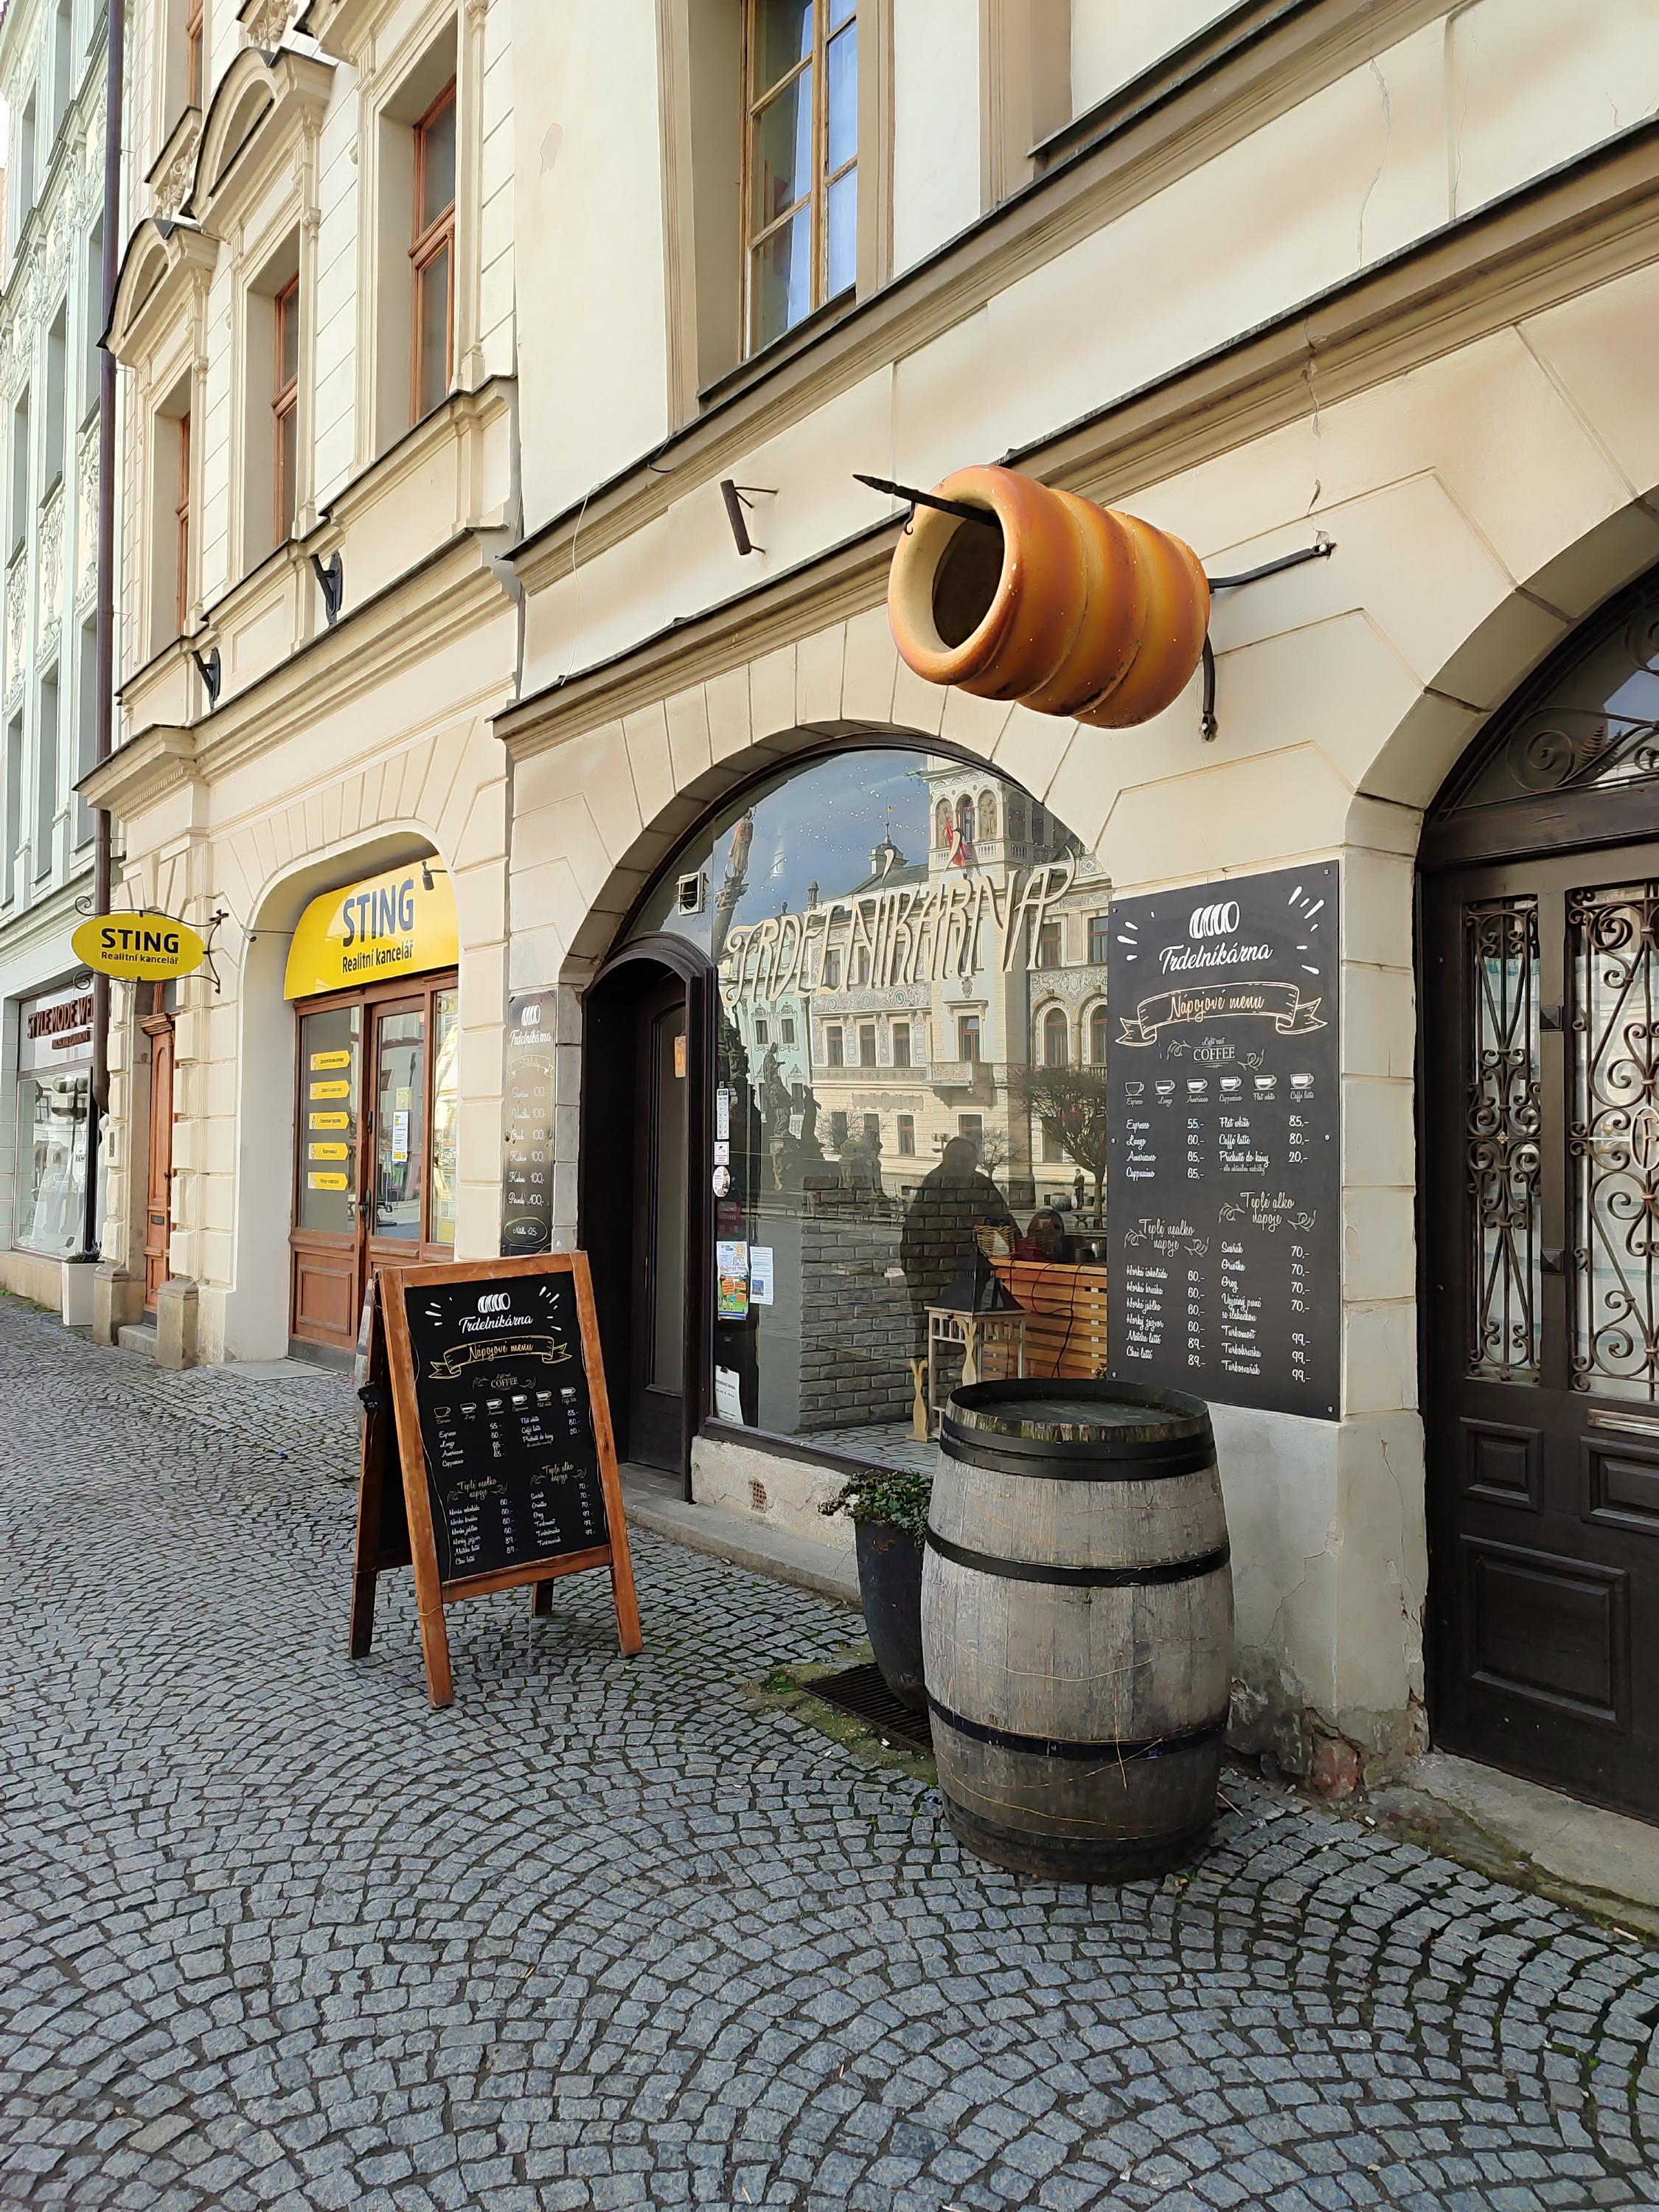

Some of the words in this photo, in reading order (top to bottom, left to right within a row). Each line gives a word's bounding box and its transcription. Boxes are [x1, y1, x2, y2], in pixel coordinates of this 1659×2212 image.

[343, 879, 414, 947] STING
[724, 830, 1077, 1009] TRDELNÍKÁRNA
[102, 928, 179, 953] STING
[102, 951, 138, 962] Realitní
[140, 954, 179, 965] kancelář
[343, 948, 375, 974] Realitní
[376, 939, 414, 967] kancelář
[1159, 942, 1273, 974] Trdelníkárna
[1167, 989, 1225, 1022] Nápojové
[1229, 995, 1265, 1009] menu
[27, 1008, 52, 1040] STYLE
[52, 999, 78, 1032] MODE
[1193, 1047, 1236, 1061] COFFEE
[1187, 1119, 1205, 1130] 55,-
[1219, 1116, 1234, 1128] Flat
[1234, 1116, 1250, 1127] white
[1289, 1115, 1310, 1127] 85,-
[1187, 1134, 1205, 1146] 60,-
[1289, 1133, 1310, 1145] 80,-
[1245, 1150, 1253, 1162] do
[1288, 1151, 1308, 1164] 20,-
[1240, 1192, 1270, 1211] Teplé
[1273, 1192, 1295, 1210] alko
[1138, 1218, 1166, 1239] Teplé
[1167, 1220, 1194, 1237] nealko
[1252, 1212, 1282, 1232] nápoje
[1153, 1237, 1180, 1258] nápoje
[1291, 1246, 1310, 1259] 70,-
[1188, 1270, 1206, 1283] 60,-
[1291, 1264, 1310, 1276] 70,-
[1222, 1276, 1239, 1293] Grog
[1291, 1281, 1310, 1295] 70,-
[1188, 1287, 1206, 1299] 60,-
[1188, 1304, 1206, 1317] 60,-
[1291, 1300, 1310, 1313] 70,-
[459, 1314, 533, 1334] Trdelníkárna
[1188, 1321, 1206, 1334] 60,-
[1188, 1338, 1206, 1350] 89,-
[1292, 1332, 1311, 1346] 99,-
[467, 1340, 507, 1362] Nápojové
[510, 1343, 533, 1352] menu
[1292, 1351, 1311, 1364] 99,-
[1188, 1354, 1206, 1368] 89,-
[490, 1377, 519, 1388] COFFEE
[1292, 1369, 1312, 1383] 99,-
